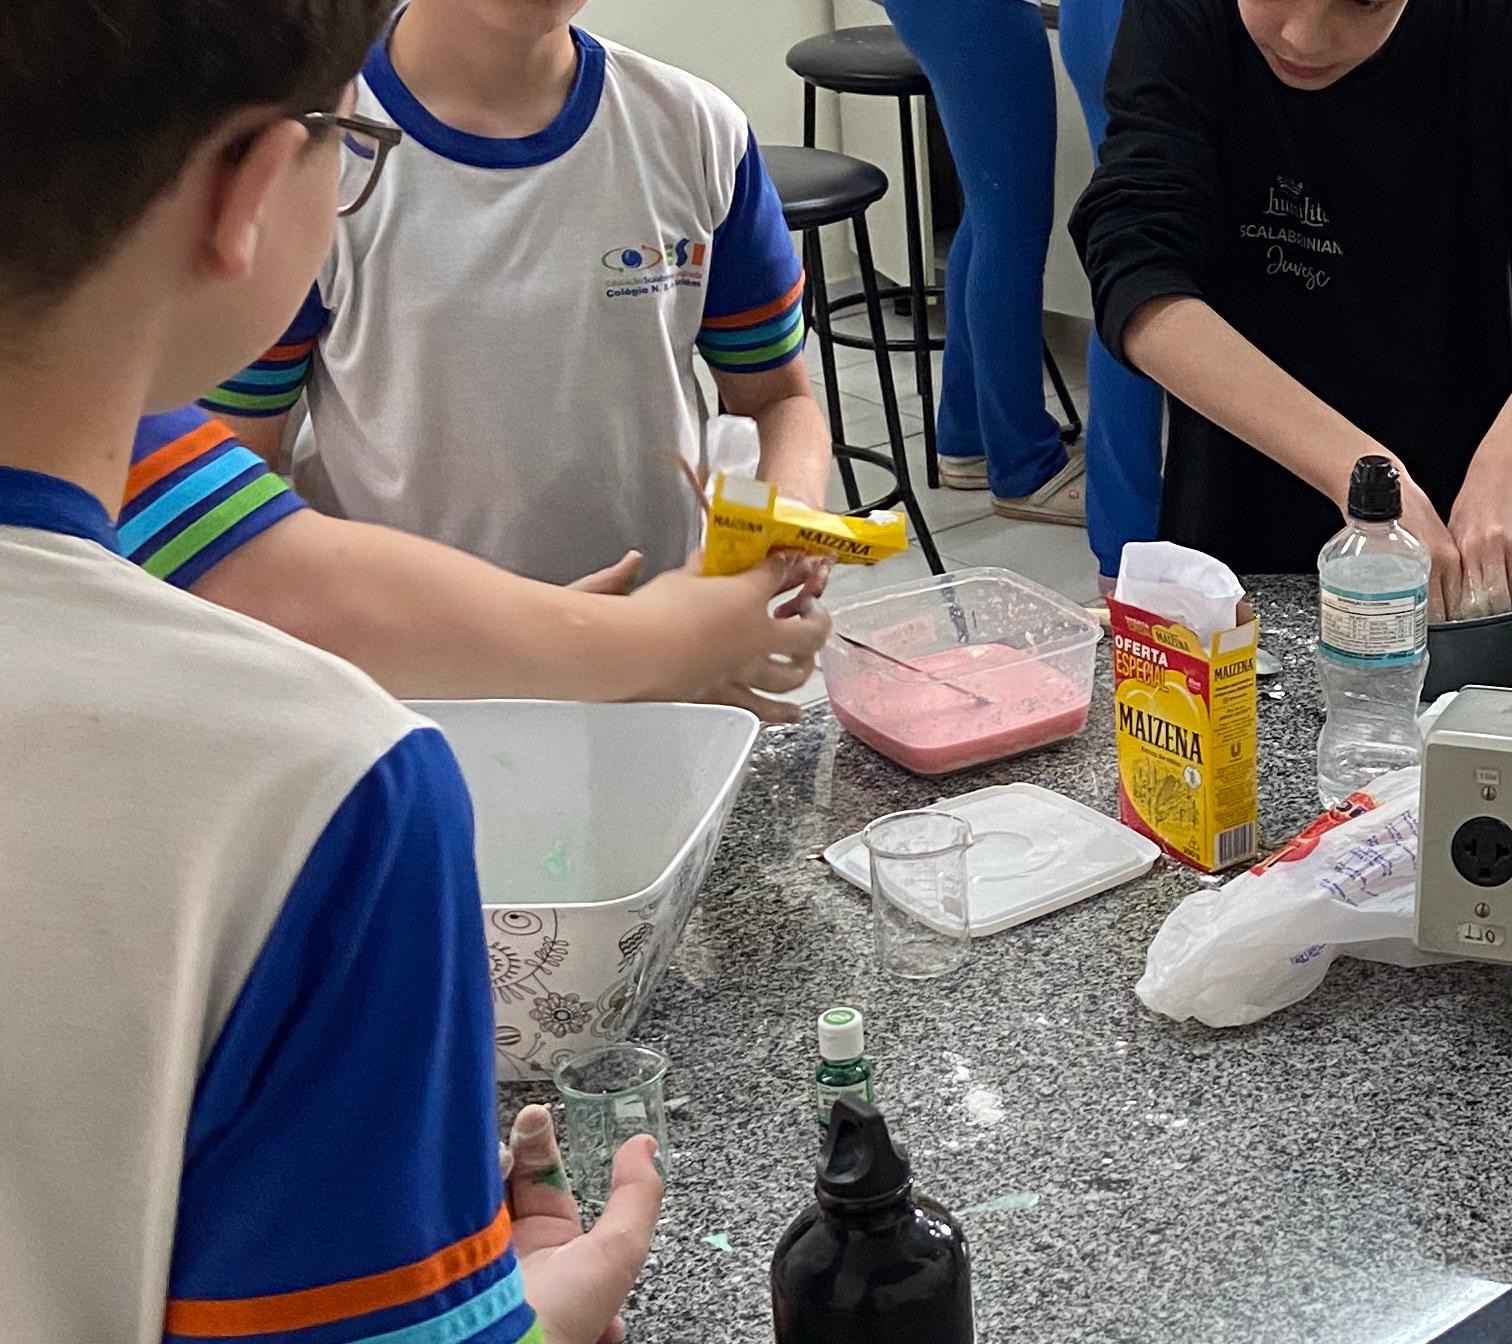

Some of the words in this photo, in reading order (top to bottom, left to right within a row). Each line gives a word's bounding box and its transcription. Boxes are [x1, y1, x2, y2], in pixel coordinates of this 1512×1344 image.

[796, 528, 874, 557] MAIZENA
[1114, 635, 1169, 668] OFERTA
[1115, 649, 1169, 694] ESPECIAL
[1214, 657, 1255, 682] MAIZENA
[1118, 701, 1204, 766] MAIZENA
